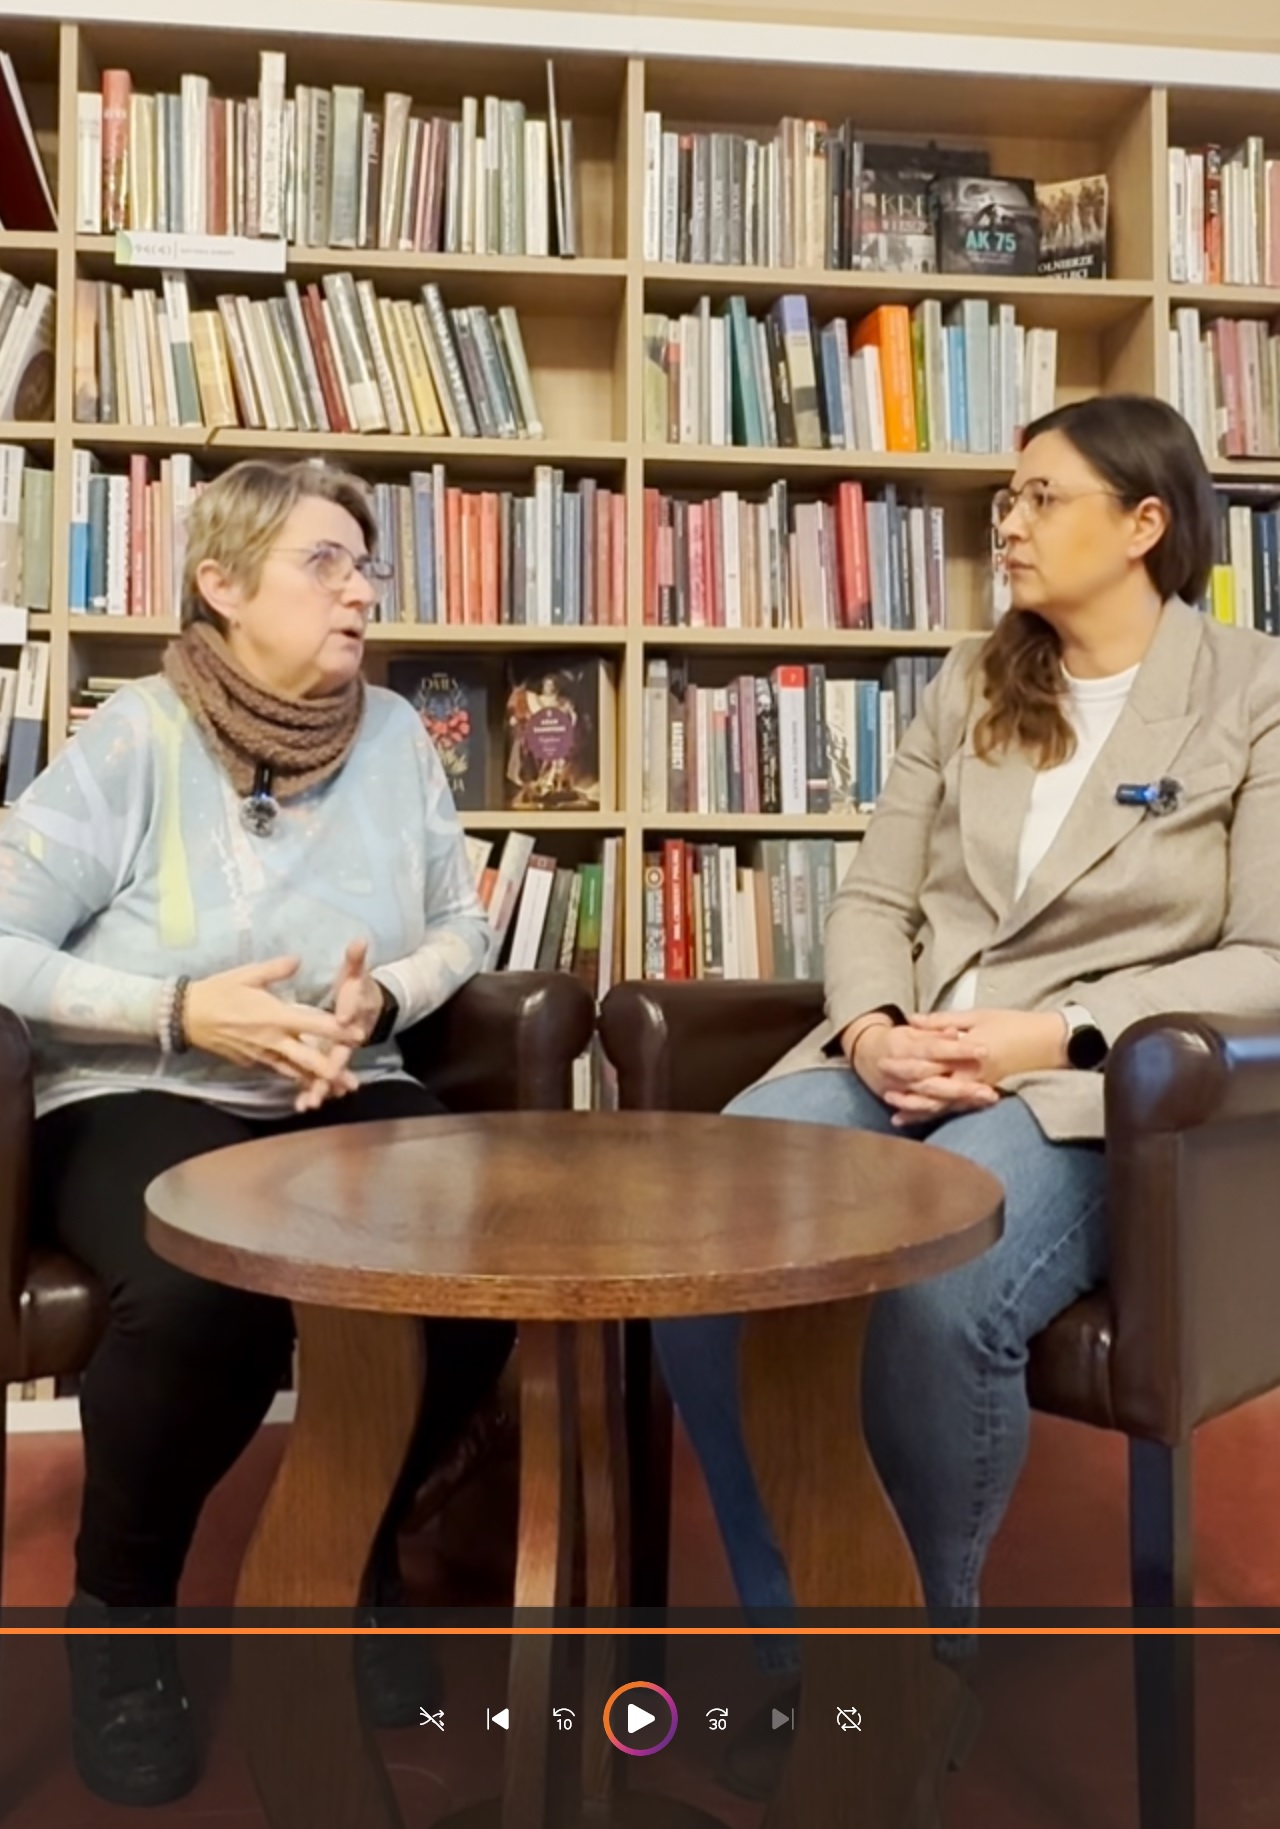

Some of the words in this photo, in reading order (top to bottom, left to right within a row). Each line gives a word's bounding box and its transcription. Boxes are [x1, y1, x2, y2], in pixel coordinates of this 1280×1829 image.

[965, 230, 989, 250] AK
[995, 232, 1017, 252] 75
[1036, 254, 1095, 273] OŁNIERZE
